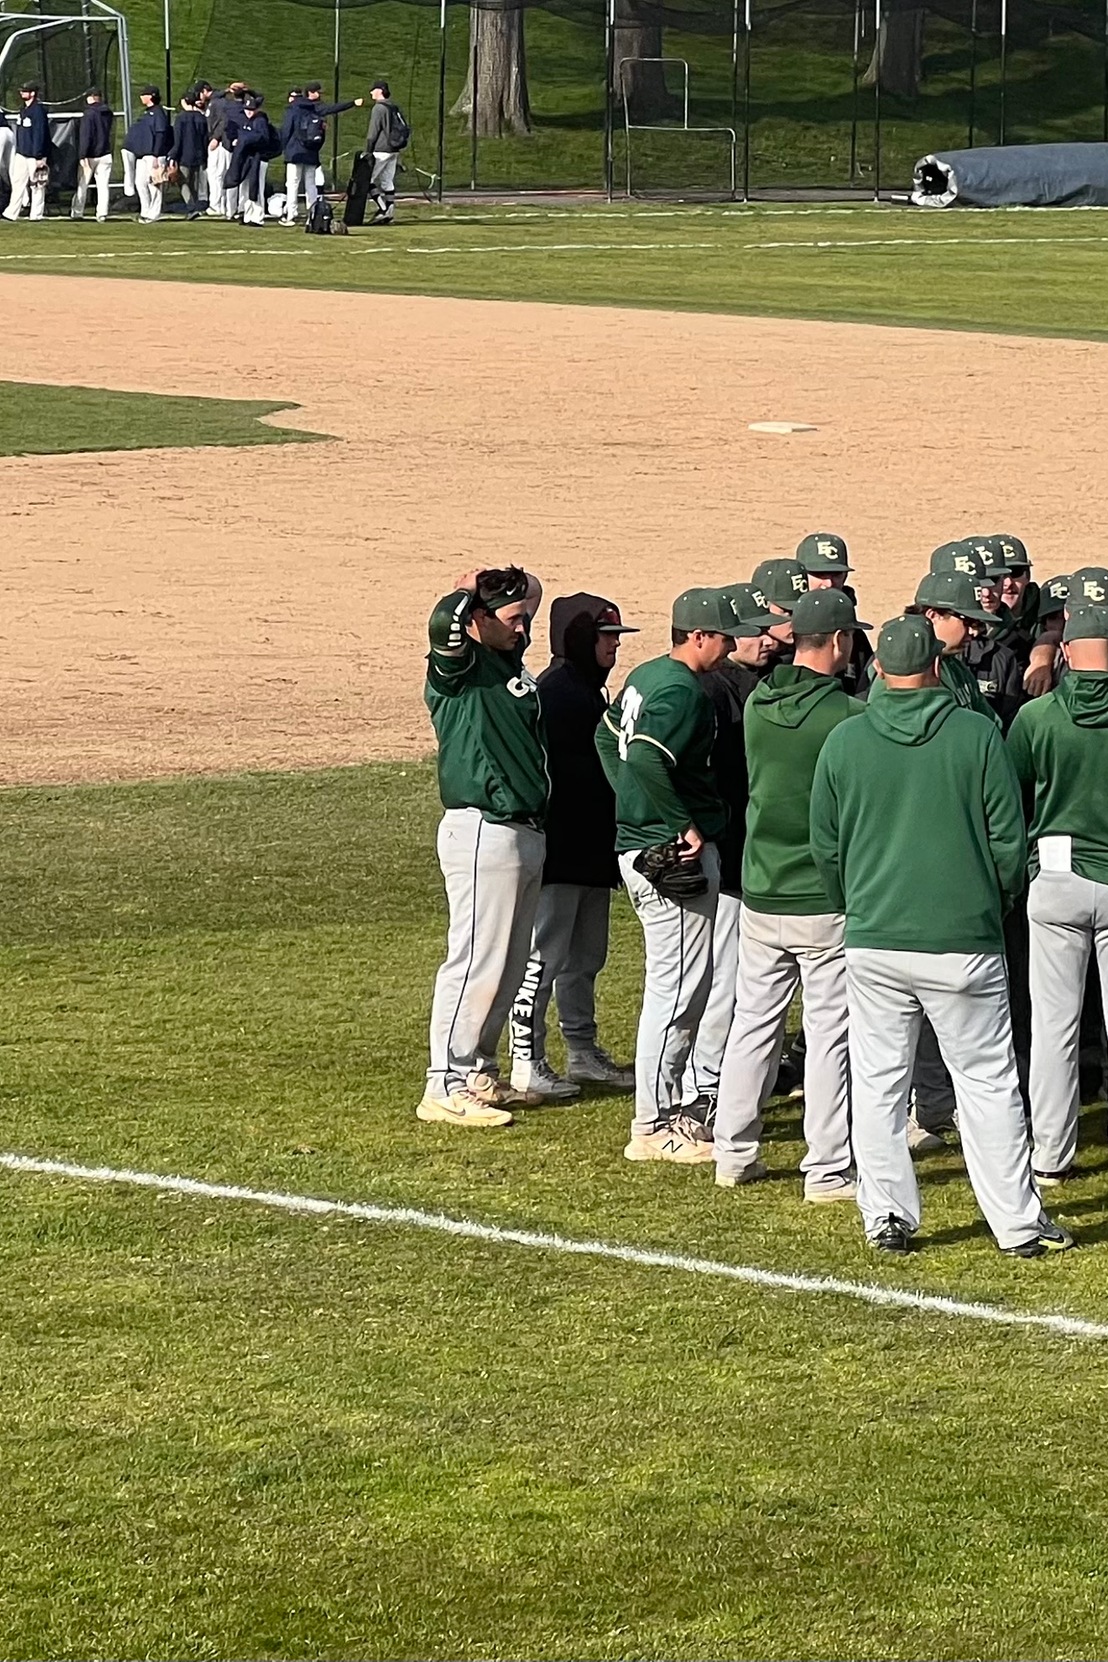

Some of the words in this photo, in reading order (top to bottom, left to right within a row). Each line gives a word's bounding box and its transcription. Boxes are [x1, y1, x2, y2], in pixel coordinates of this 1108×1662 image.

[817, 541, 839, 559] EC
[955, 556, 976, 576] EC
[791, 574, 808, 593] EC
[1050, 582, 1069, 599] EC
[1084, 581, 1105, 601] EC
[514, 961, 542, 1018] NIKE
[512, 1020, 532, 1060] AIR
[662, 1140, 684, 1154] N
